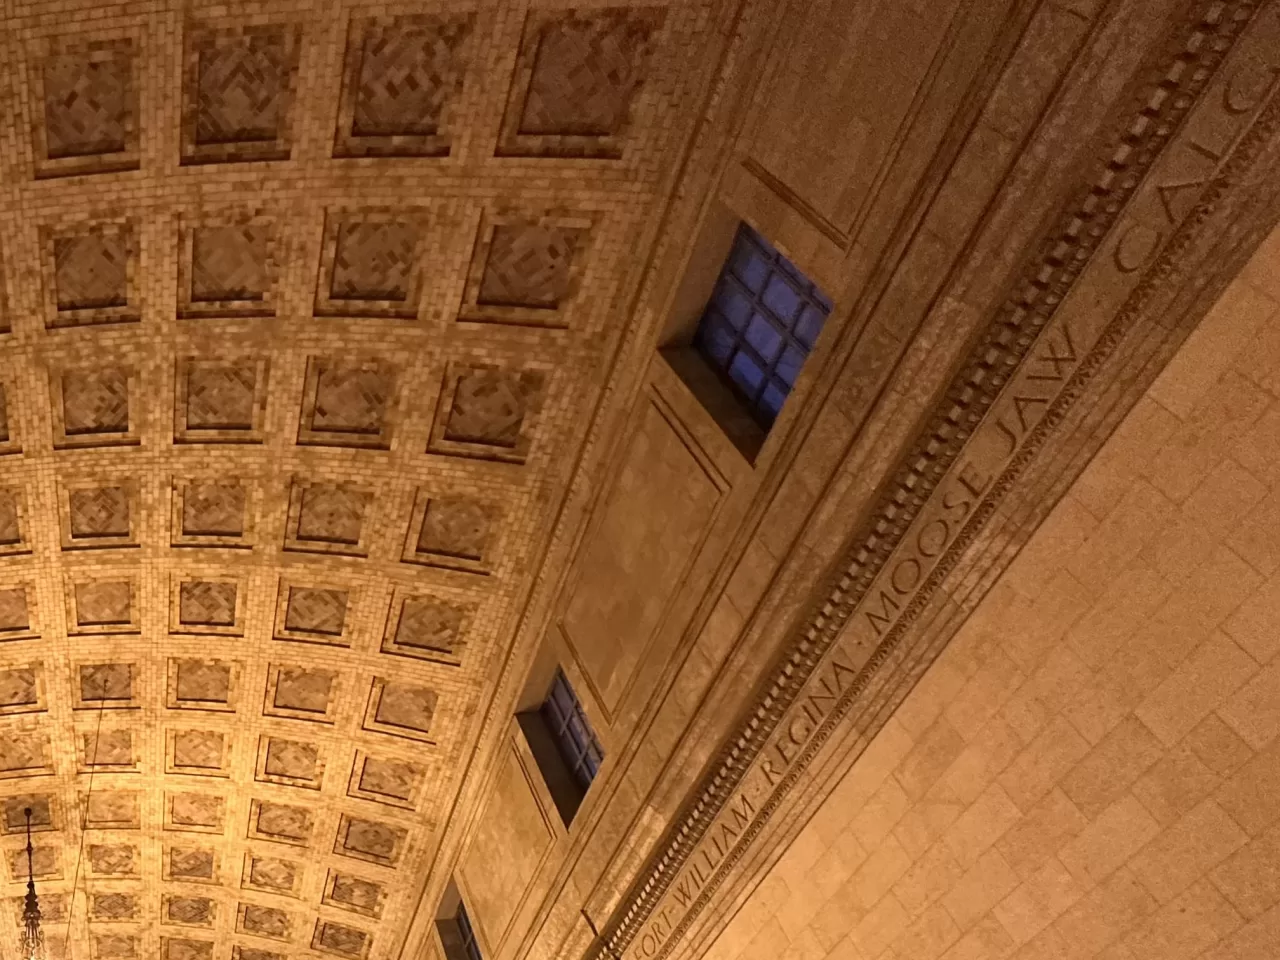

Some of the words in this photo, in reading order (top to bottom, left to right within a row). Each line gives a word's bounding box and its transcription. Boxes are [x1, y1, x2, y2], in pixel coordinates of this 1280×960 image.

[759, 659, 856, 787] REGINA
[865, 462, 994, 638] MOOSE
[995, 322, 1078, 456] JAW
